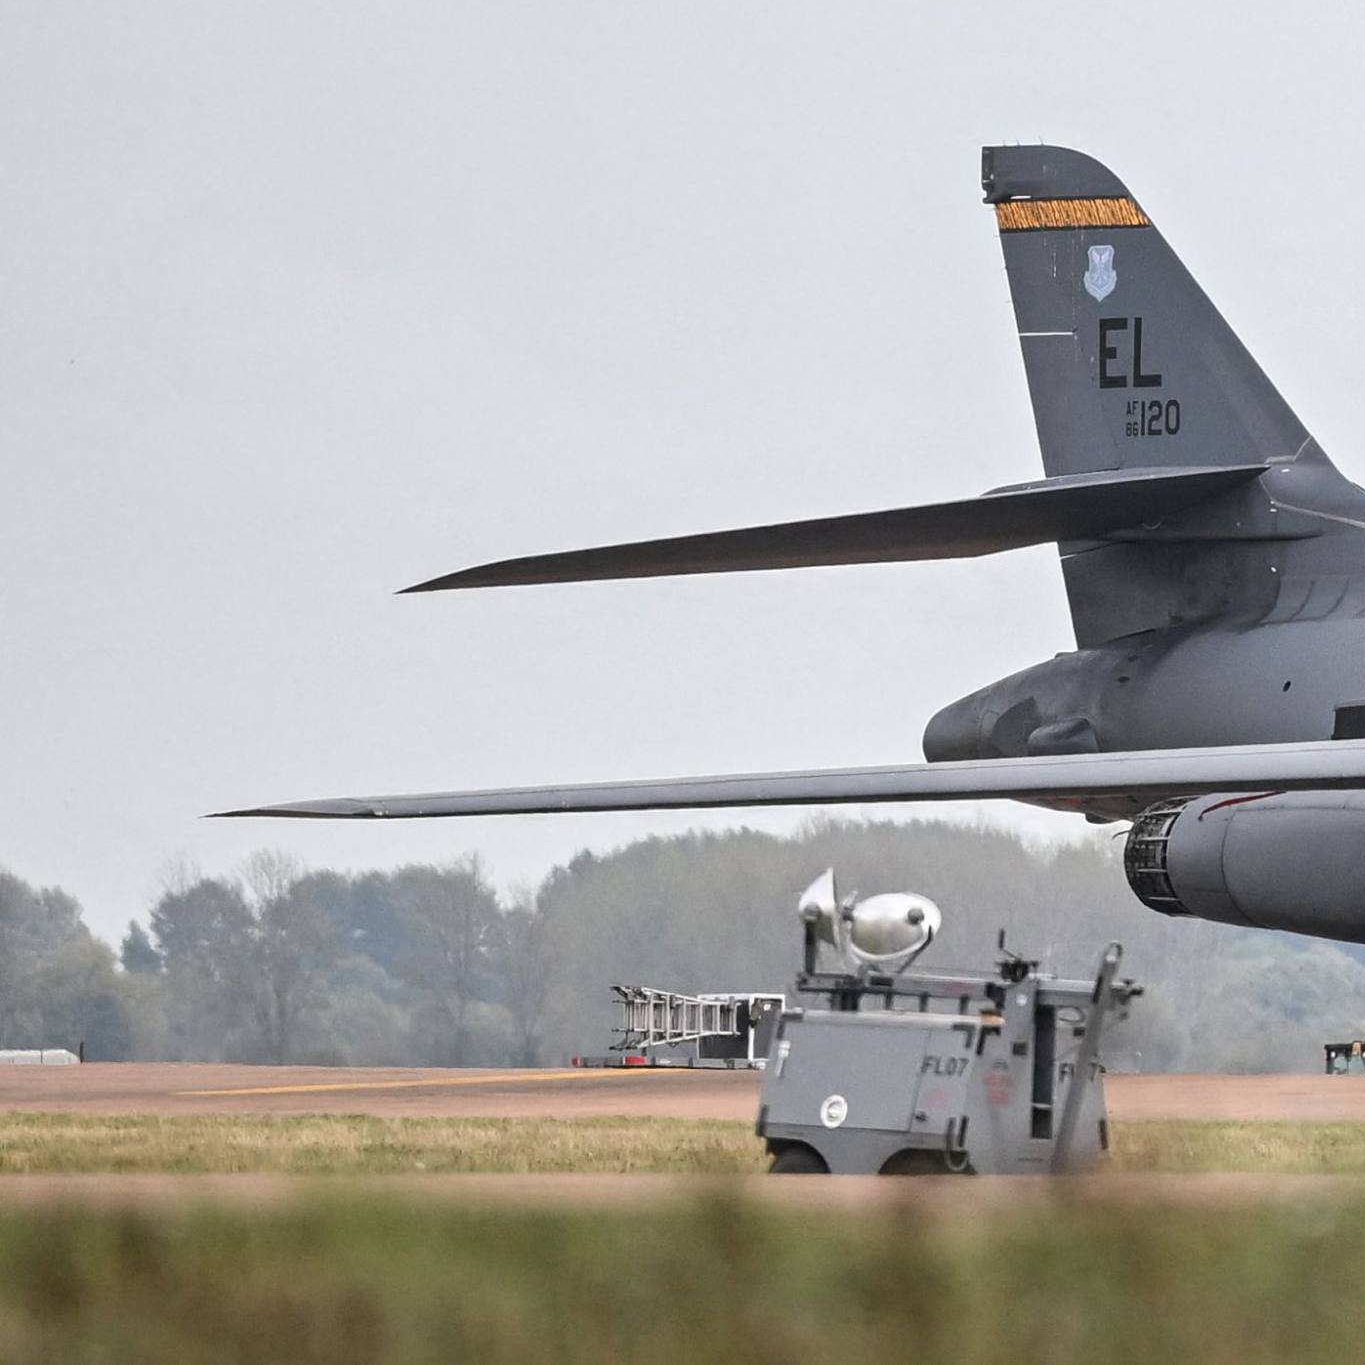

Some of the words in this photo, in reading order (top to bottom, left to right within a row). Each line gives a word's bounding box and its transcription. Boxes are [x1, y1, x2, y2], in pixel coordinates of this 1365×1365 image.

[1099, 317, 1162, 389] EL
[1126, 401, 1139, 416] AF
[1141, 399, 1180, 436] 120
[1126, 422, 1139, 437] 86
[920, 1055, 970, 1077] FL07
[1059, 1062, 1098, 1083] F7
